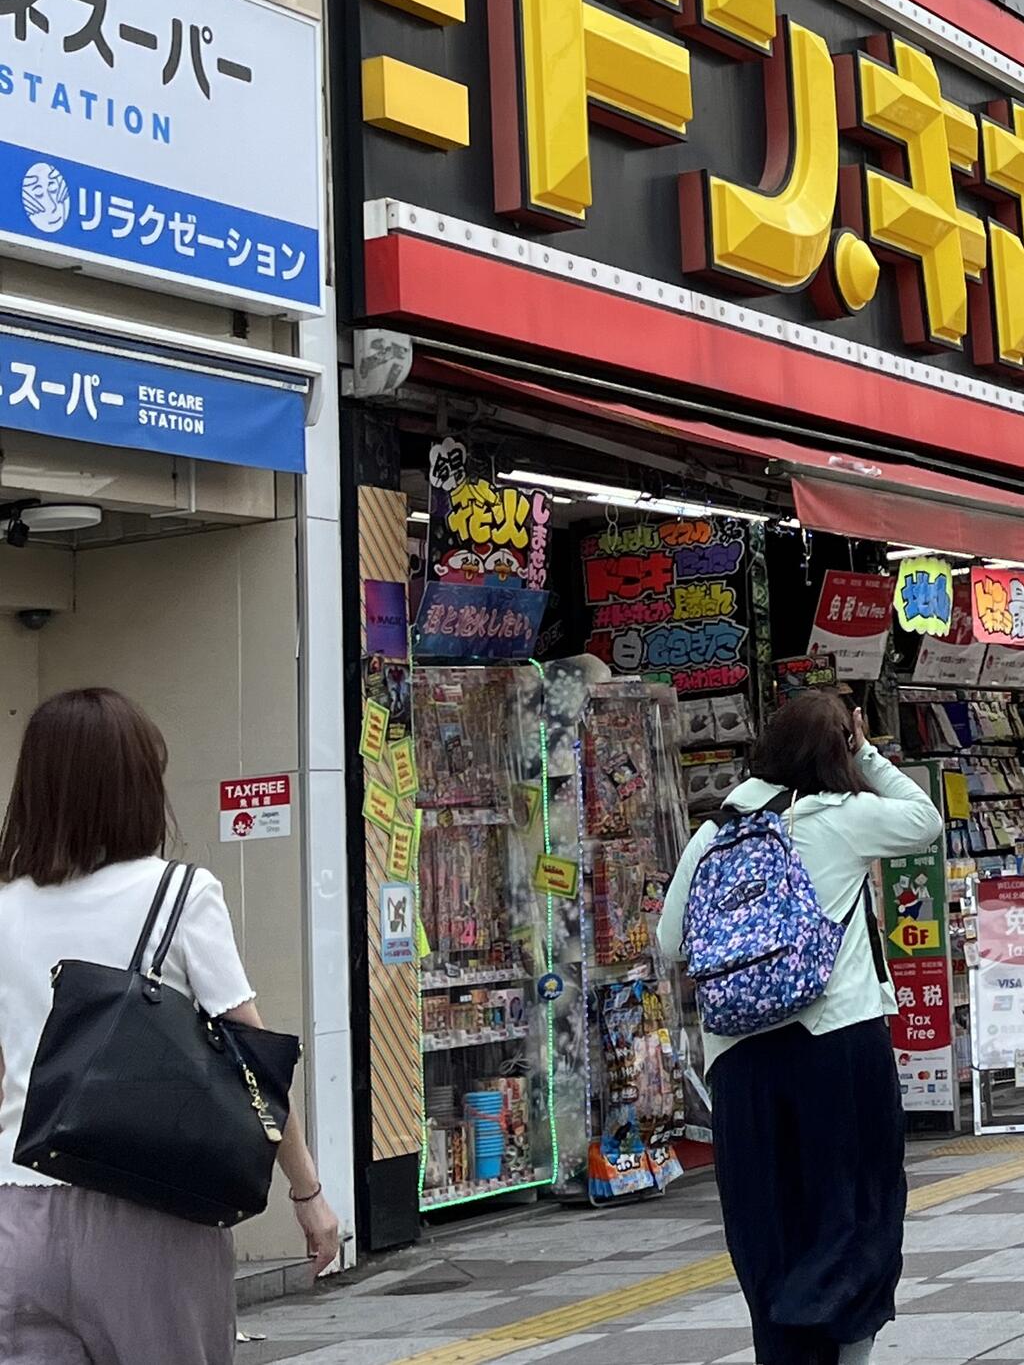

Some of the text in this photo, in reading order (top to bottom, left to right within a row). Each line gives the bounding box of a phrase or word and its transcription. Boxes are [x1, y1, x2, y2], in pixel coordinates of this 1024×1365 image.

[0, 64, 171, 145] STATION
[76, 187, 306, 281] リラクゼーション
[0, 361, 124, 422] スーパー
[138, 385, 203, 412] EYE CARE
[138, 409, 204, 434] STATION
[448, 479, 530, 549] 花火
[225, 780, 286, 799] TAXFREE
[902, 925, 929, 947] 6F
[997, 978, 1023, 989] VISA
[897, 984, 944, 1009] 免税
[908, 1013, 931, 1026] Tax
[906, 1027, 936, 1041] Free
